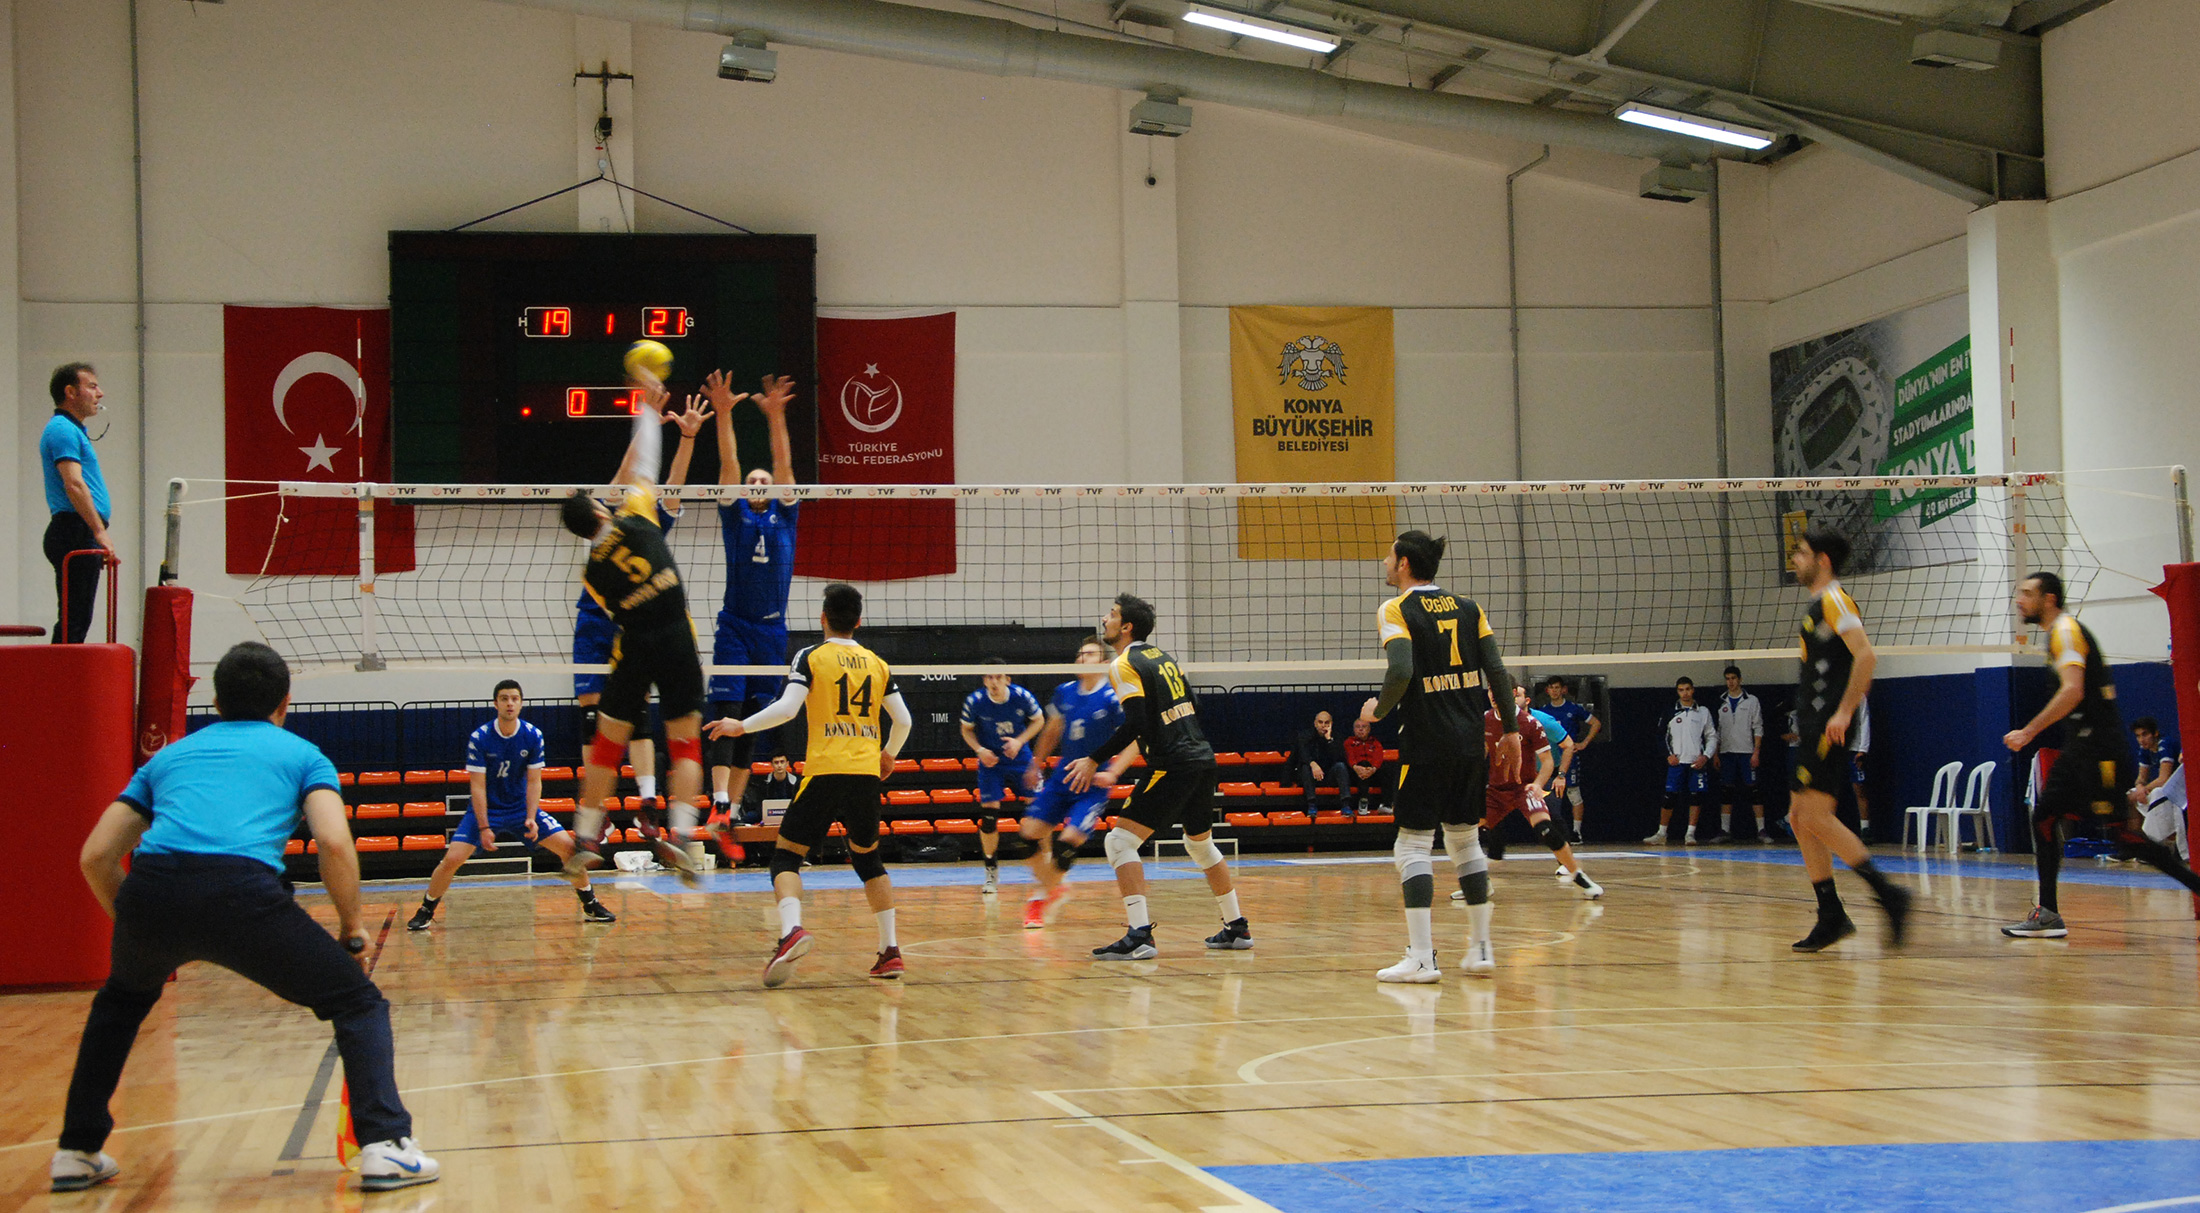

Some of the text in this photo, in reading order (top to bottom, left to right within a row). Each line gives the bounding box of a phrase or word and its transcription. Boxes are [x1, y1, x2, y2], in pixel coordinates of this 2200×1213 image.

[518, 310, 695, 335] H 19 1 21 G
[1950, 354, 1963, 378] EN
[570, 389, 587, 416] 0
[1284, 399, 1343, 414] KONYA
[1253, 415, 1373, 440] BÜYÜKŞEHİR
[848, 442, 898, 453] TÜRKİYE
[1278, 438, 1349, 452] BELEDİYESİ
[863, 448, 943, 465] FEDERASYONU
[532, 488, 550, 496] TVF
[664, 488, 681, 496] TVF
[707, 488, 725, 496] TVF
[750, 488, 767, 496] TVF
[792, 488, 810, 496] TVF
[835, 488, 852, 496] TVF
[878, 488, 895, 496] TVF
[920, 488, 937, 496] TVF
[962, 488, 979, 496] TVF
[1003, 488, 1020, 496] TVF
[1045, 488, 1062, 496] TVF
[1086, 488, 1102, 496] TVF
[752, 534, 770, 563] 4
[610, 545, 652, 584] 5
[1419, 595, 1459, 613] ÖZGÜR
[1437, 618, 1463, 667] 7
[837, 651, 867, 669] ÜMİT
[1158, 661, 1185, 701] 13
[1422, 673, 1461, 693] KONYA
[835, 672, 873, 717] 14
[931, 712, 949, 723] TIME
[497, 760, 511, 778] 12
[1697, 779, 1704, 789] 5
